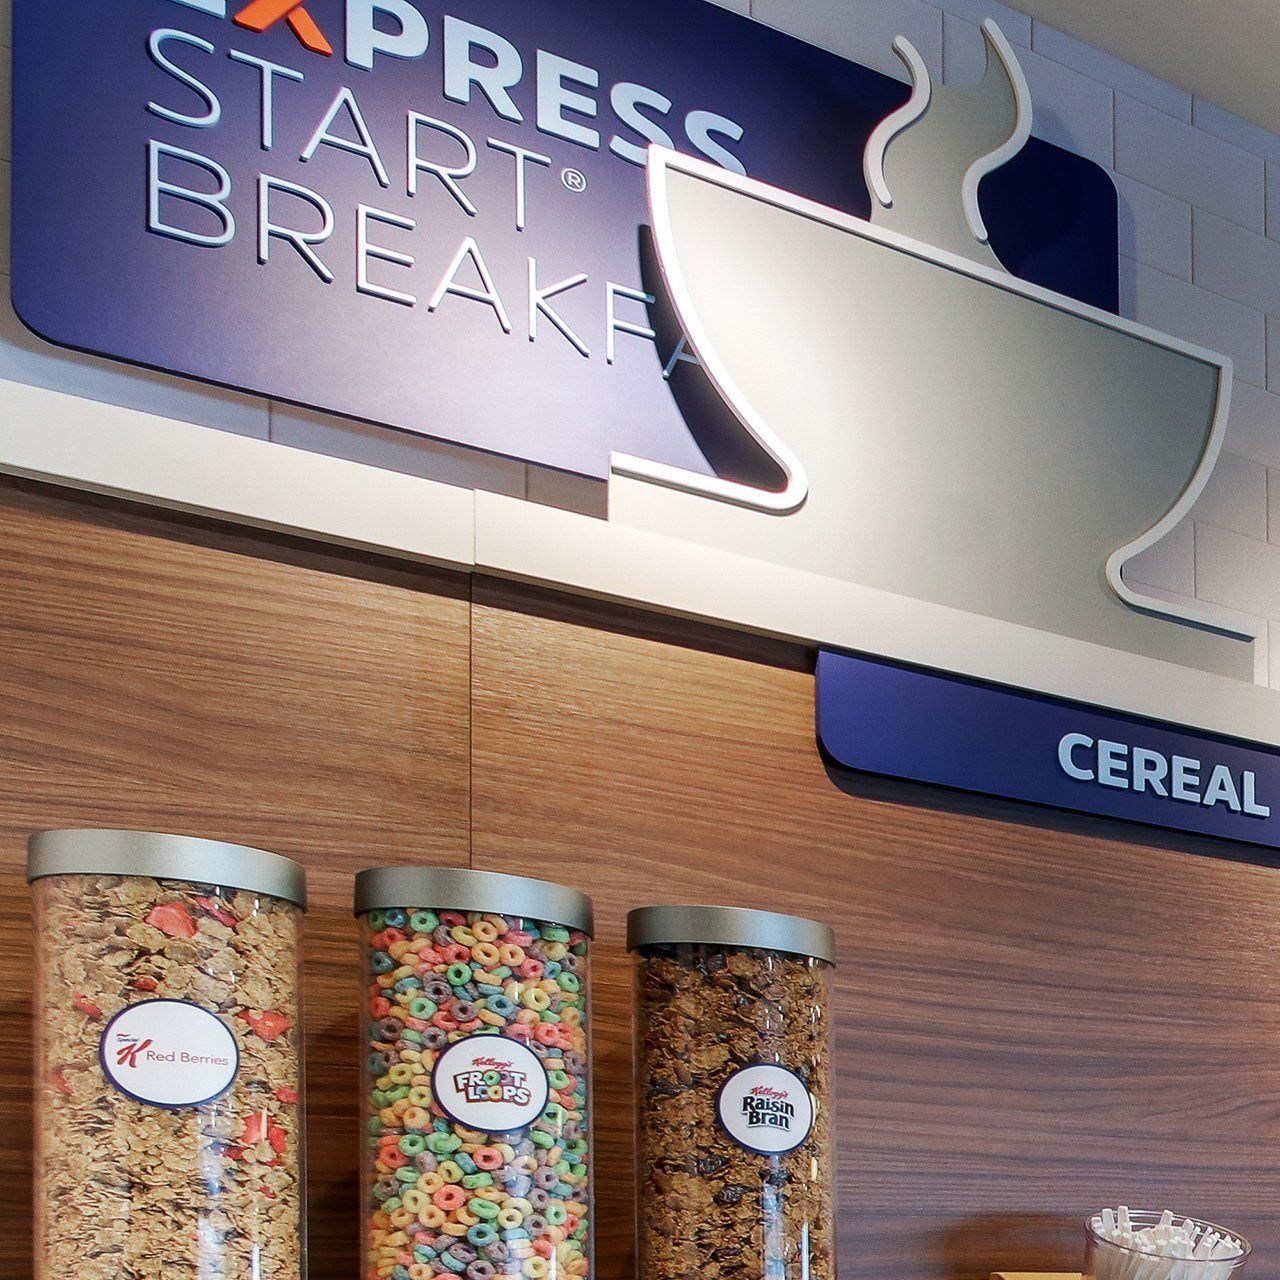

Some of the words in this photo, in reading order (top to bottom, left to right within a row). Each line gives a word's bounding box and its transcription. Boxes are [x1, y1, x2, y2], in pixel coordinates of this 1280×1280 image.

[164, 0, 748, 178] PRESS
[1057, 732, 1272, 819] CEREAL
[117, 1039, 153, 1068] K
[146, 1050, 175, 1062] Red
[181, 1052, 229, 1066] Berries
[453, 1069, 527, 1092] FROOT
[466, 1084, 531, 1106] LOOPS
[742, 1096, 794, 1117] Raisin
[748, 1111, 790, 1129] Bran
